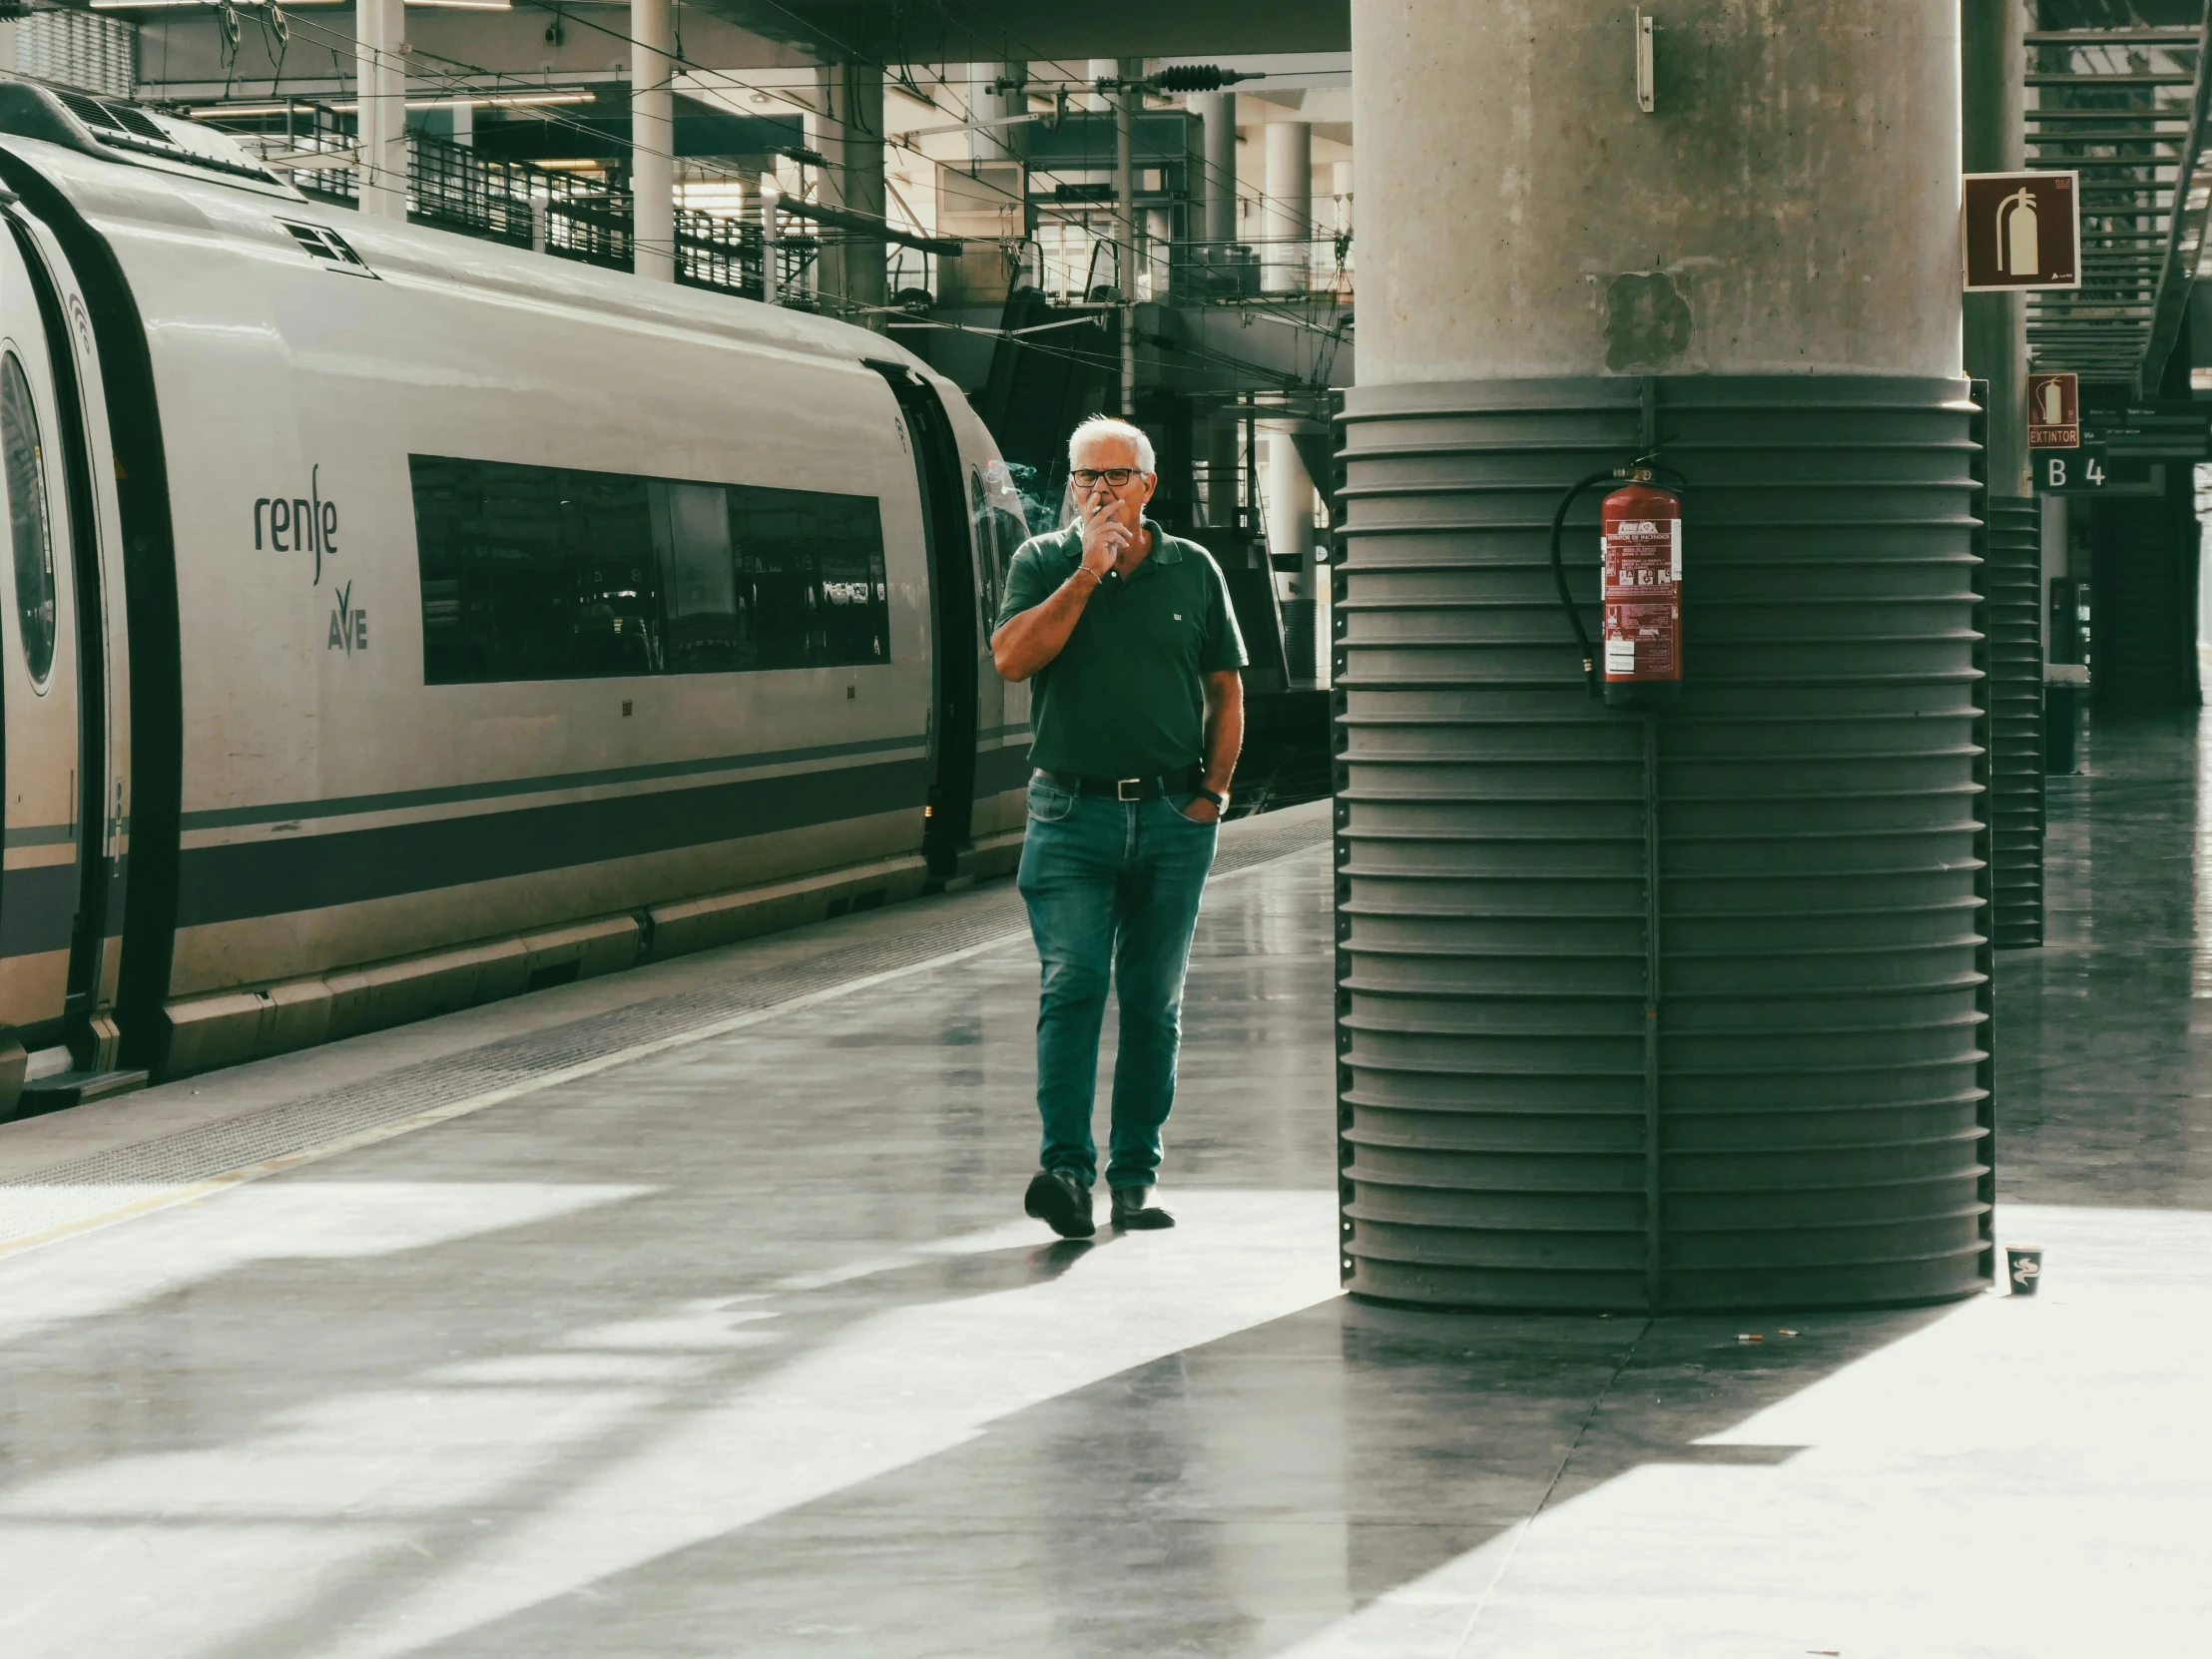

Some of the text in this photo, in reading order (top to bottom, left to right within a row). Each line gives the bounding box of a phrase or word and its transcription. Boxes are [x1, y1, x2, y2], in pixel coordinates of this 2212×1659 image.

[2030, 430, 2077, 443] EXTINTOR
[2049, 458, 2105, 486] B 4
[254, 463, 337, 587] renfe
[327, 579, 367, 660] AVE
